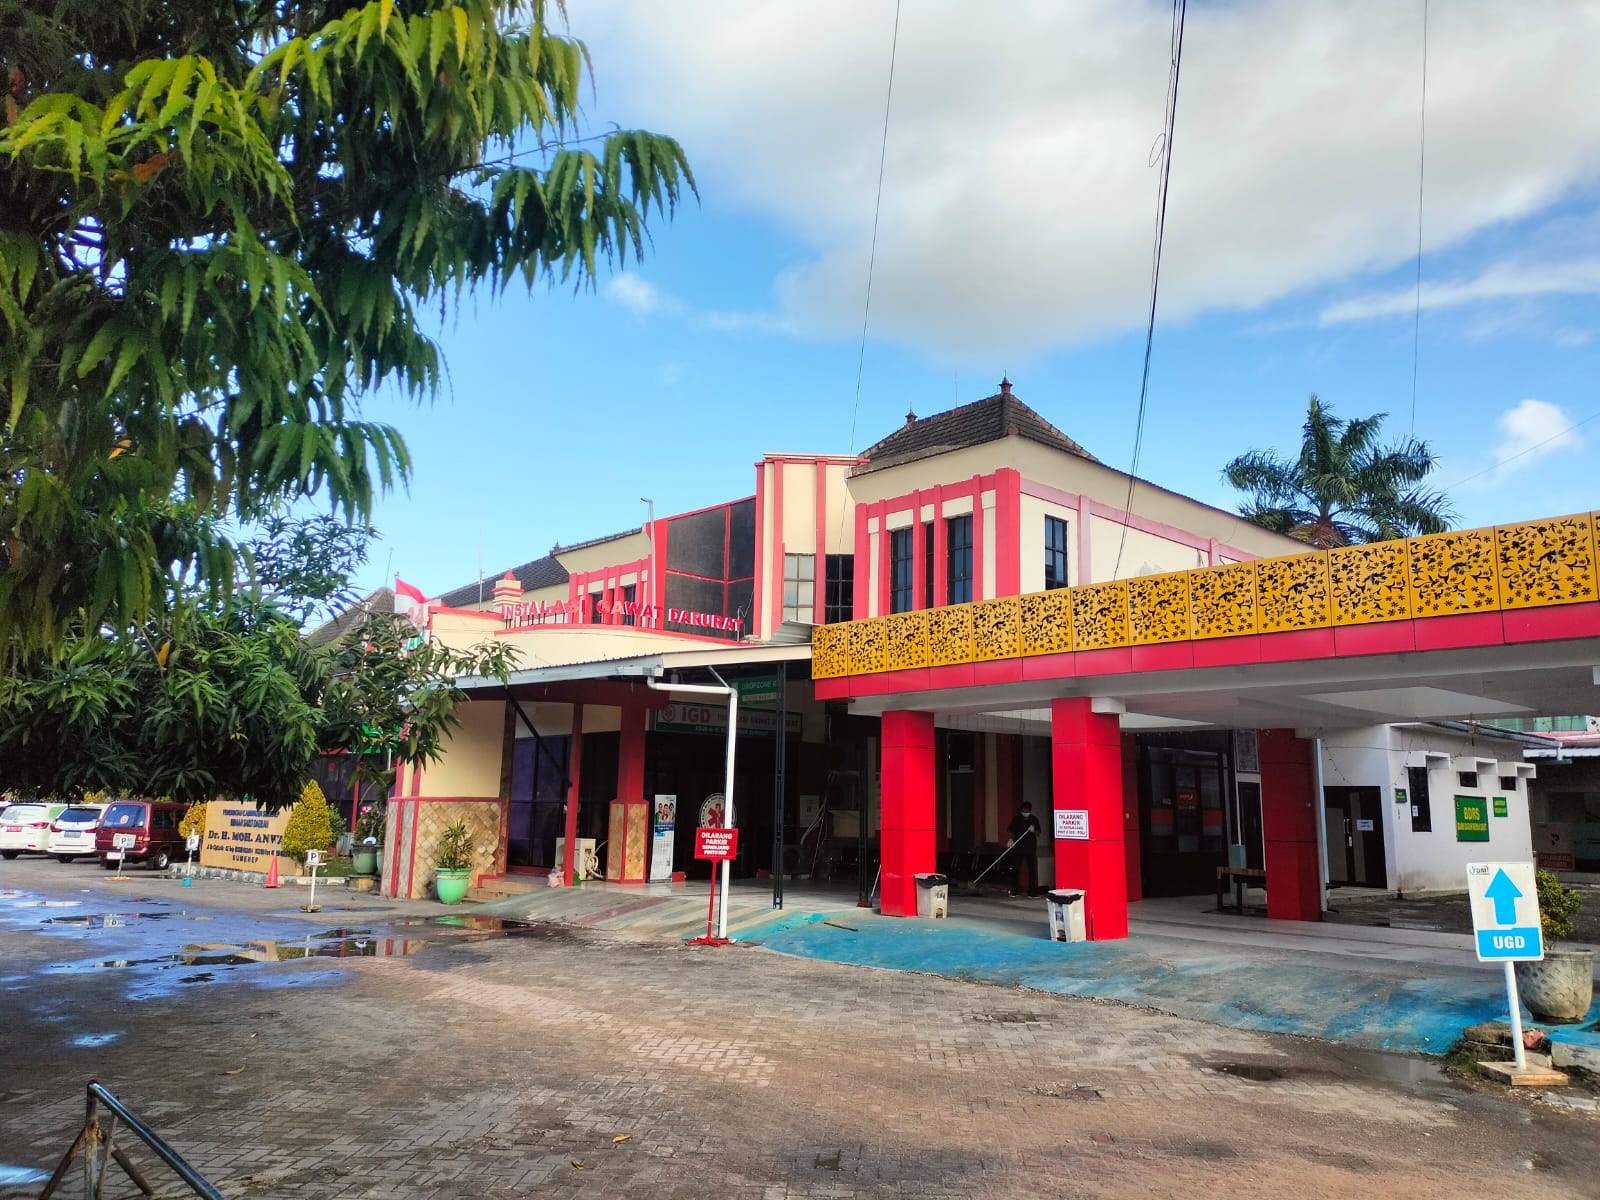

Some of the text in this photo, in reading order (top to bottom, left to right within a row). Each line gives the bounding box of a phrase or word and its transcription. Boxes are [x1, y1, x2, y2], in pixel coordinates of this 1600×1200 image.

[501, 599, 744, 631] INSTALASI GAWAT DARURAT
[681, 707, 711, 723] IGD
[1493, 935, 1525, 949] UGD
